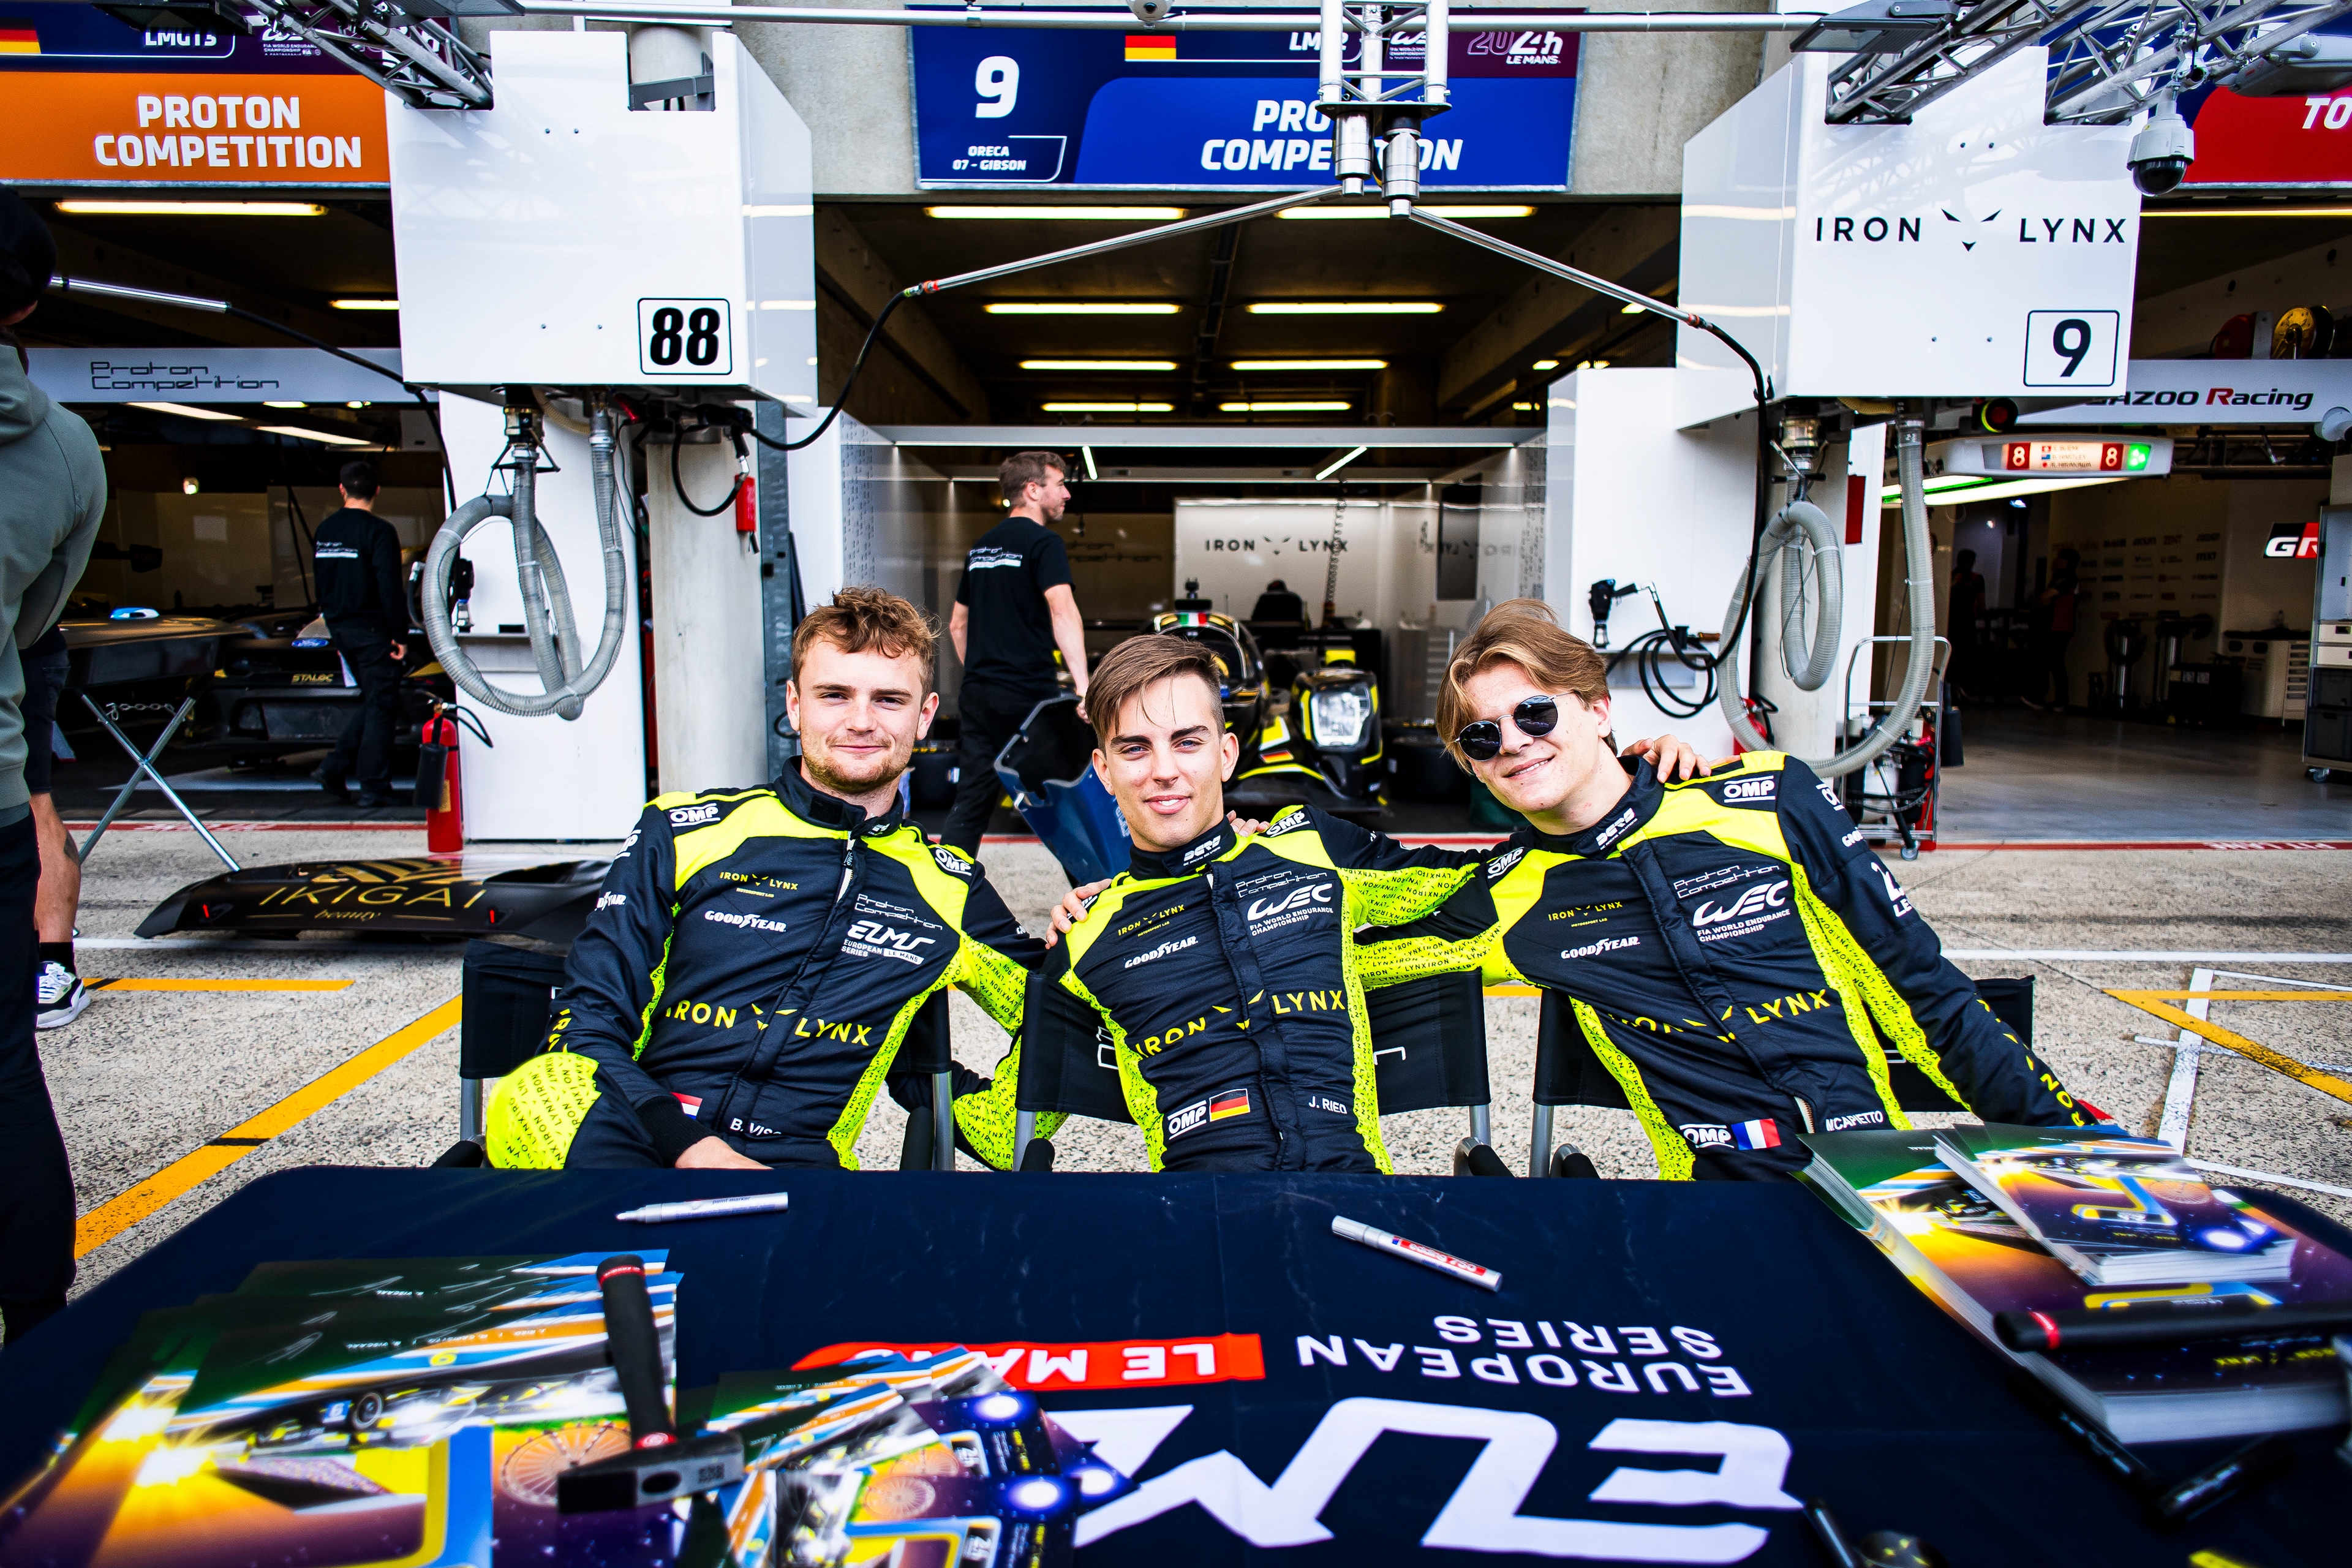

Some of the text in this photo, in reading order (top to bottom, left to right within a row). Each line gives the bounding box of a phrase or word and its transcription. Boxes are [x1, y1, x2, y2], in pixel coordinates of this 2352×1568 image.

[975, 56, 1020, 118] 9
[138, 96, 300, 129] PROTON
[94, 135, 362, 168] COMPETITION
[968, 146, 1009, 157] ORECA
[952, 160, 968, 170] 07
[980, 160, 1026, 170] GIBSON
[1816, 216, 2128, 244] IRON LYNX
[650, 307, 721, 366] 88
[2051, 318, 2092, 378] 9
[90, 361, 209, 376] Proton
[91, 375, 280, 393] Competition
[2206, 387, 2314, 410] Racing
[2013, 447, 2026, 467] 8
[2105, 447, 2117, 467] 8
[1205, 539, 1348, 552] IRON LYNX
[1723, 780, 1775, 799] OMP
[670, 805, 719, 824] OMP
[1618, 818, 1638, 835] SOLUTIONS
[935, 848, 971, 873] OMP
[1487, 848, 1523, 875] OMP
[719, 872, 799, 890] IRON LYNX
[1235, 870, 1292, 889] Proton
[1237, 872, 1327, 899] Competition
[1673, 864, 1740, 891] Proton
[1676, 864, 1780, 899] Competition
[258, 886, 487, 908] IKIGAI
[857, 894, 914, 914] Proton
[1247, 883, 1333, 921] WEC
[1692, 880, 1789, 927] WEC
[704, 910, 786, 932] GOODYEAR
[854, 902, 943, 930] Competition
[1118, 904, 1185, 936] IRON LYNX
[1250, 907, 1334, 931] FIA WORLD ENDURANCE
[1548, 901, 1623, 921] IRON LYNX
[1696, 909, 1791, 937] FIA WORLD ENDURANCE
[1137, 924, 1162, 937] MOTORSPORT
[1251, 914, 1310, 937] CHAMPIONSHIP
[1571, 919, 1599, 928] MOTORSPORT
[1698, 924, 1765, 943] CHAMPIONSHIP
[841, 946, 869, 958] SERIES
[843, 938, 883, 955] EUROPEAN
[900, 952, 918, 962] MANS
[1125, 935, 1199, 969] GOODYEAR
[1560, 936, 1641, 960] GOODYEAR
[1744, 989, 1831, 1025] LYNX
[794, 1017, 872, 1046] LYNX
[1135, 989, 1346, 1059] IRON LYNX
[1308, 1096, 1320, 1109] J.
[729, 1118, 744, 1132] B.
[1167, 1105, 1207, 1136] OMP
[1683, 1127, 1732, 1144] OMP
[1408, 1242, 1477, 1272] edding 750
[1432, 1314, 1724, 1359] SERIES
[1121, 1342, 1216, 1382] LE
[1295, 1333, 1753, 1398] EUROPEAN
